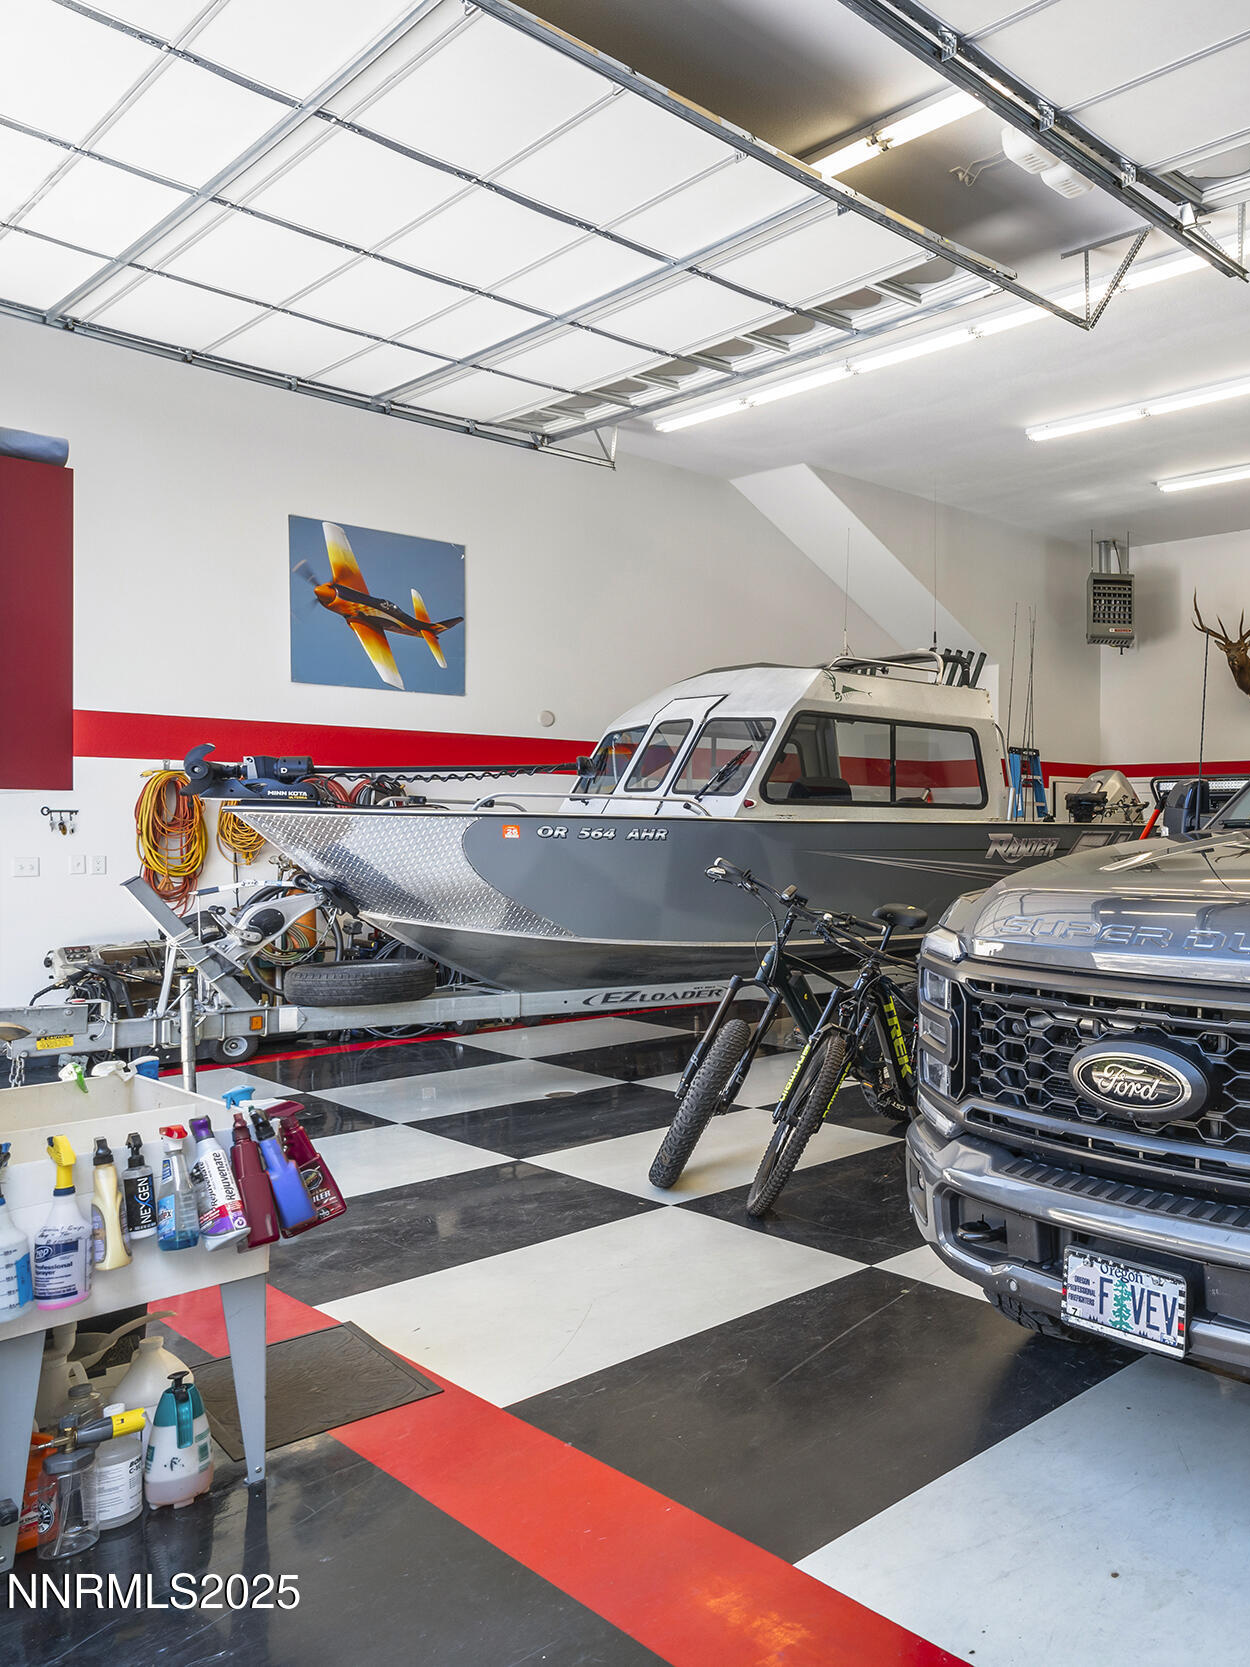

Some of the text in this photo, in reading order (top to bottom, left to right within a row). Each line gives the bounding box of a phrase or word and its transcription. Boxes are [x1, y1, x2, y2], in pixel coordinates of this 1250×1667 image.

[537, 825, 669, 841] OR 564 AHR
[1000, 915, 1175, 949] SUPER
[883, 995, 913, 1078] TREK
[1100, 1063, 1159, 1101] Ford
[212, 1152, 236, 1201] Rejuvenate
[134, 1177, 153, 1224] NEXGEN
[1100, 1264, 1144, 1285] Oregon
[1099, 1276, 1177, 1336] F VEV
